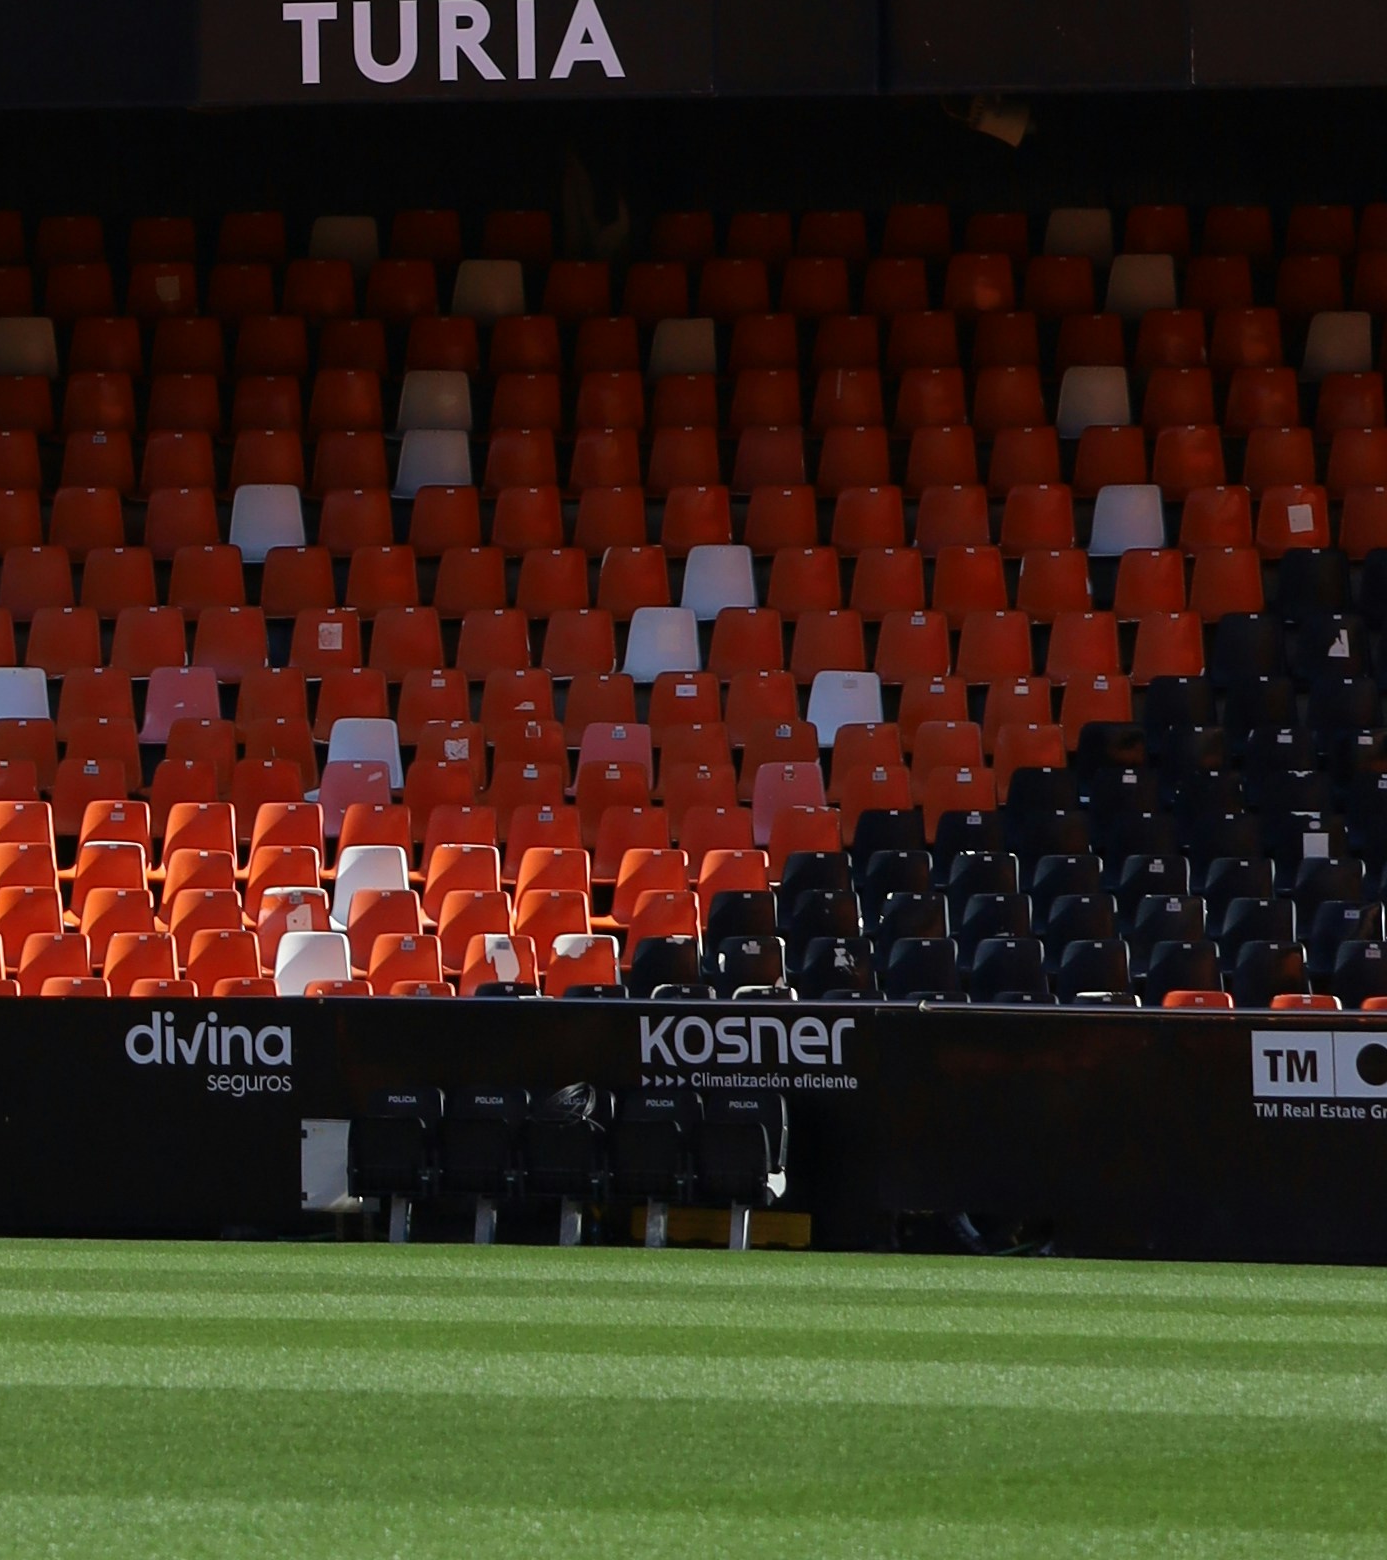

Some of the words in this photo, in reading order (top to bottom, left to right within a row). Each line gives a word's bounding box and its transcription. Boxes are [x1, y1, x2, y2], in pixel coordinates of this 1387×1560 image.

[124, 1011, 292, 1065] divina
[1262, 1049, 1318, 1083] TM
[205, 1071, 291, 1097] seguros
[690, 1071, 790, 1089] Climatización
[794, 1073, 858, 1089] eficiente
[388, 1095, 417, 1104] POLICIA
[475, 1096, 504, 1105] POLICIA
[646, 1099, 675, 1107] POLICIA
[729, 1100, 759, 1109] POLICIA
[1253, 1103, 1278, 1117] TM
[1283, 1103, 1314, 1117] Real
[1320, 1104, 1366, 1118] Estate
